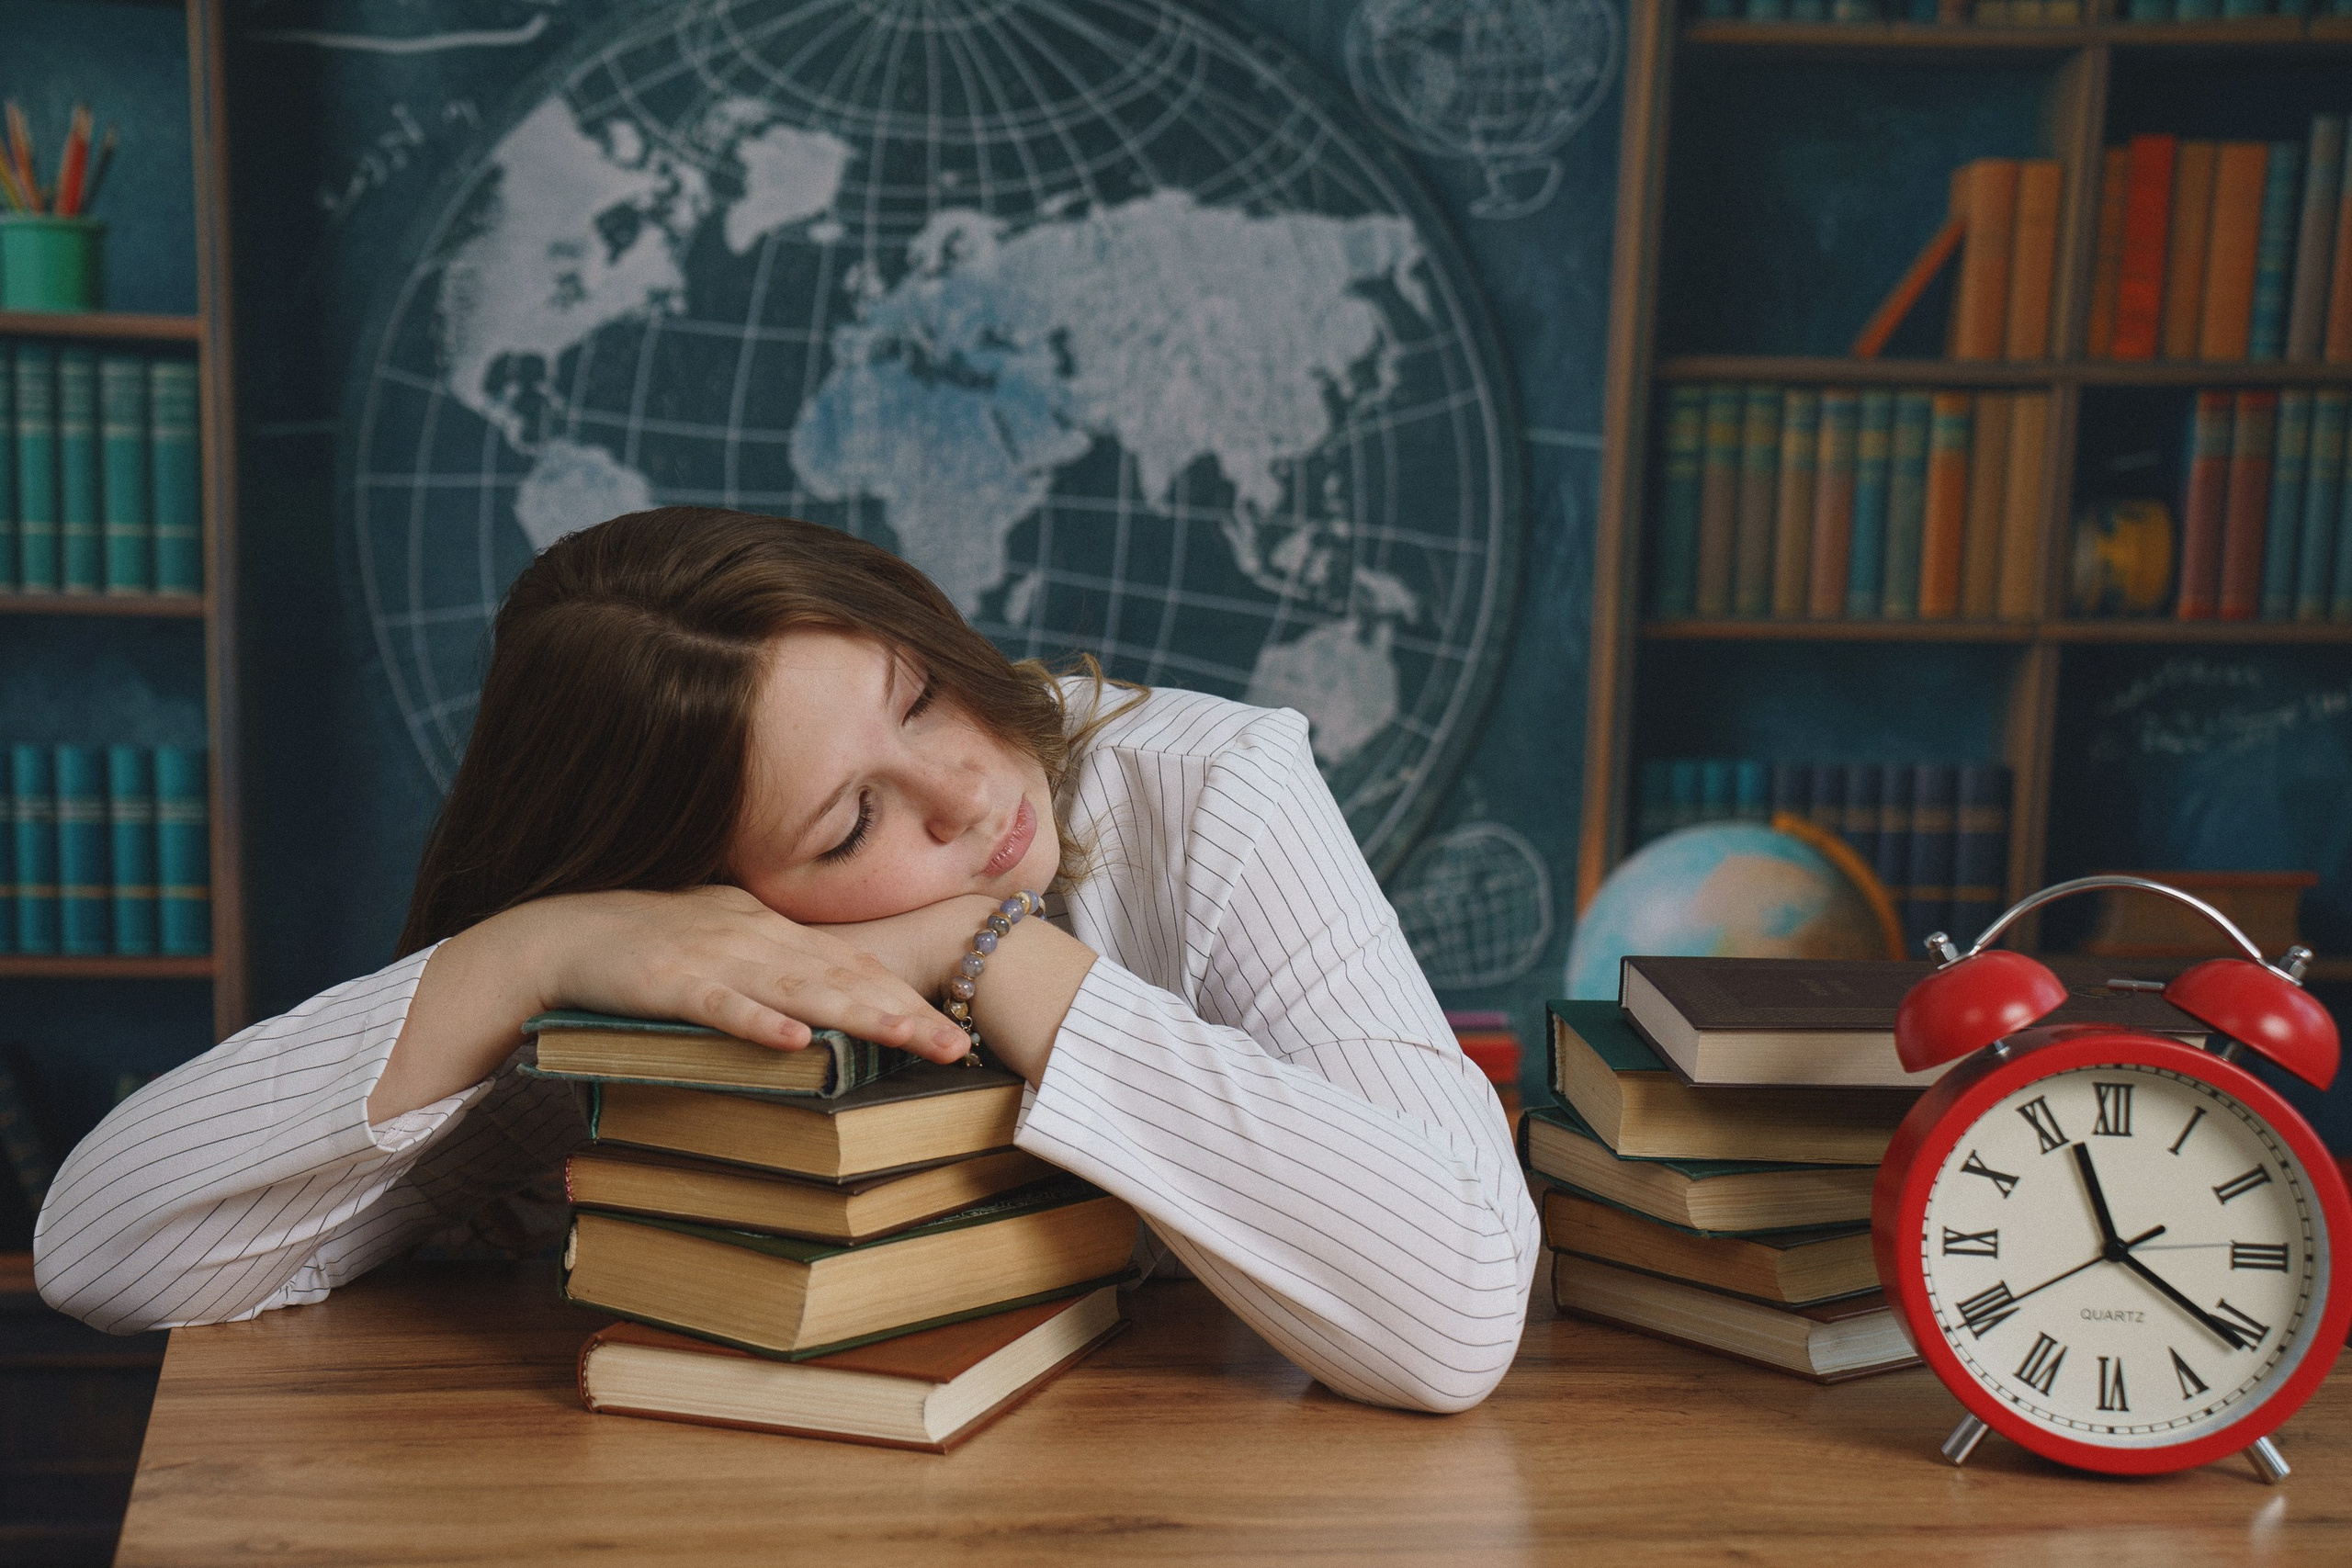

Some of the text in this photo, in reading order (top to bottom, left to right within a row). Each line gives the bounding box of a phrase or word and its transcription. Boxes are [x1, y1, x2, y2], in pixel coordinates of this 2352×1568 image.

[2015, 1094, 2070, 1155] XI
[2092, 1082, 2134, 1136] XII
[2167, 1105, 2207, 1156] I
[1959, 1149, 2019, 1199] X
[2211, 1163, 2272, 1205] II
[1942, 1225, 1998, 1258] IX
[2229, 1240, 2289, 1273] III
[2079, 1307, 2144, 1324] QUARTZ
[2012, 1331, 2068, 1397] VII
[2096, 1356, 2130, 1412] VI
[2167, 1346, 2210, 1402] V
